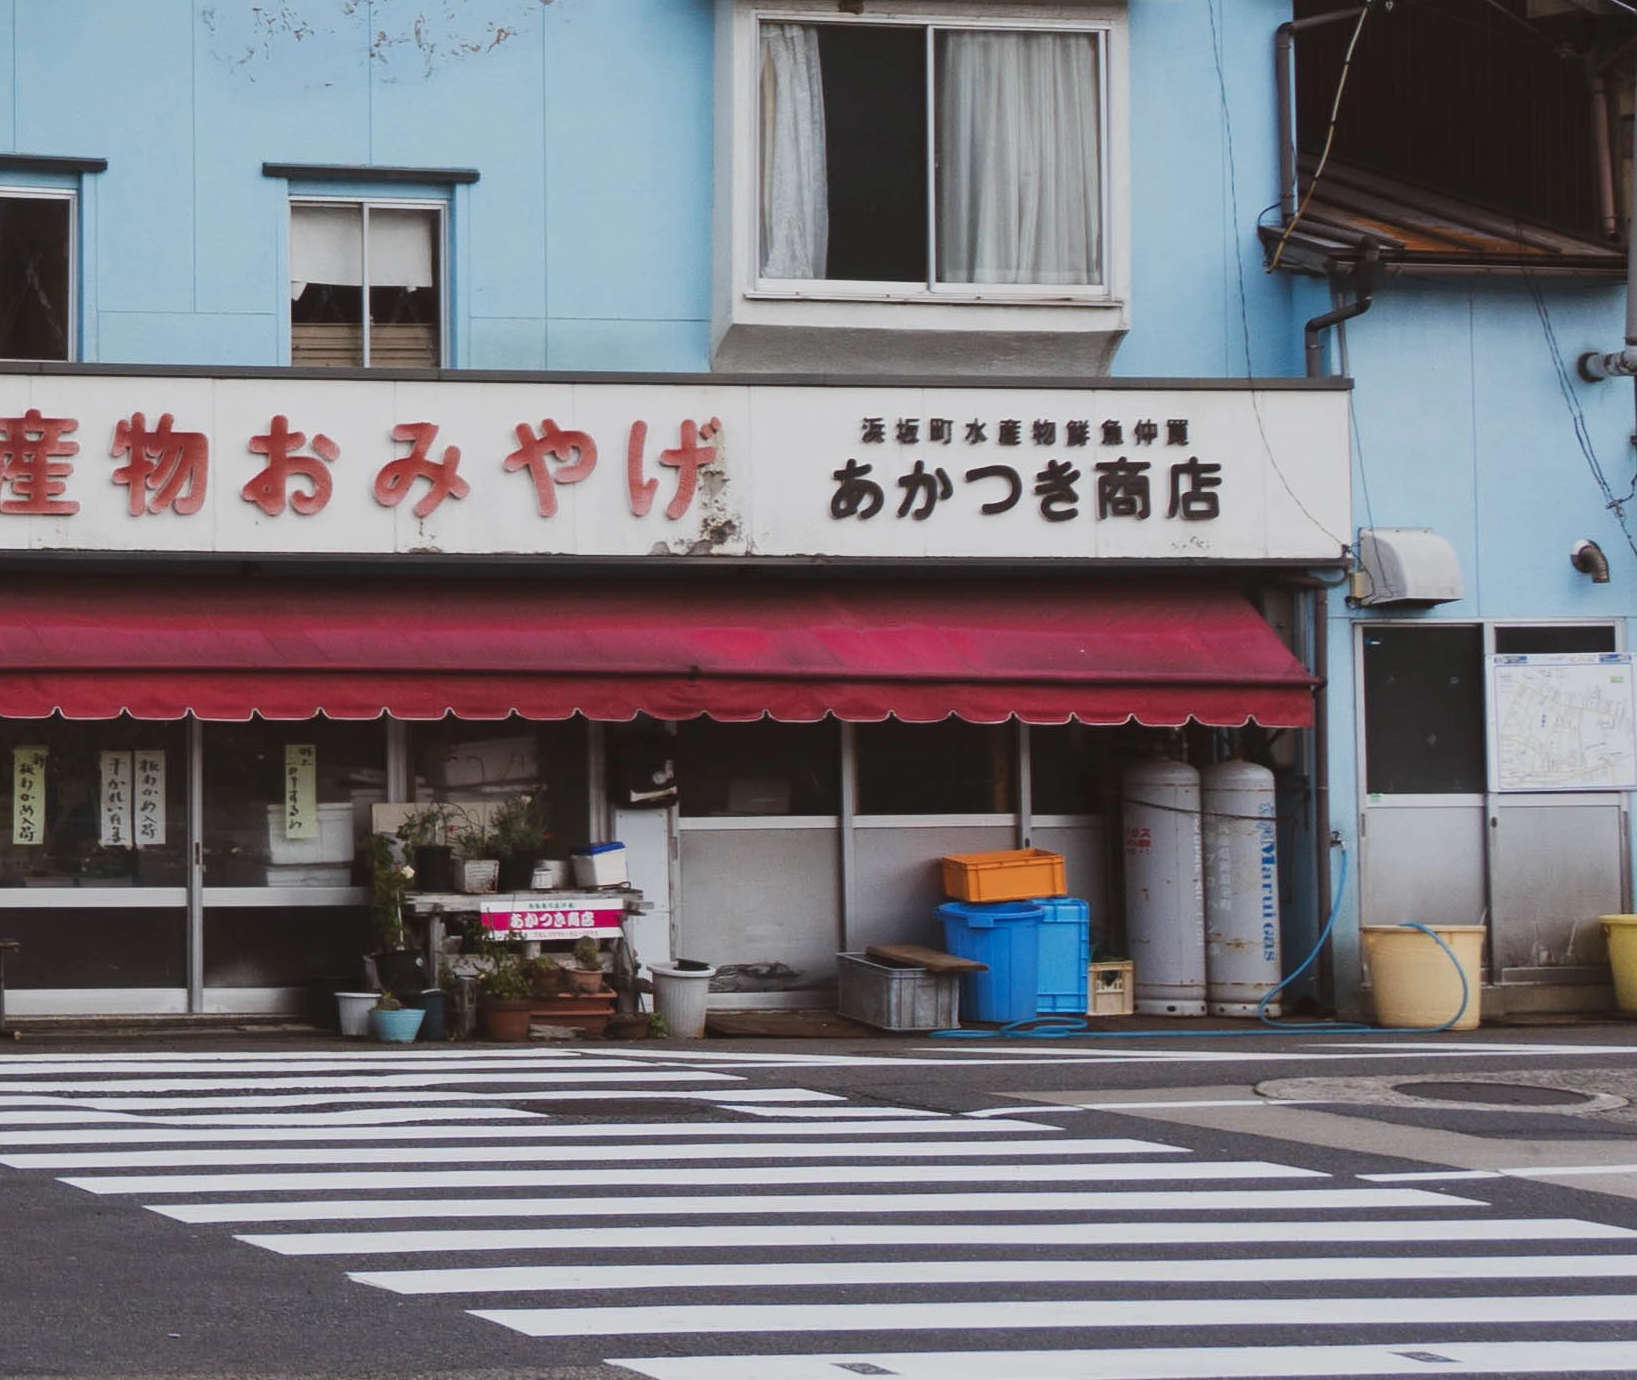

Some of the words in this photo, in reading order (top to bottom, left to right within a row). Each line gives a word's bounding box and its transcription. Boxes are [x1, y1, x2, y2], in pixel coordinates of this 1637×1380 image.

[829, 456, 1223, 523] あかつき商店
[509, 911, 595, 929] あかつき商店
